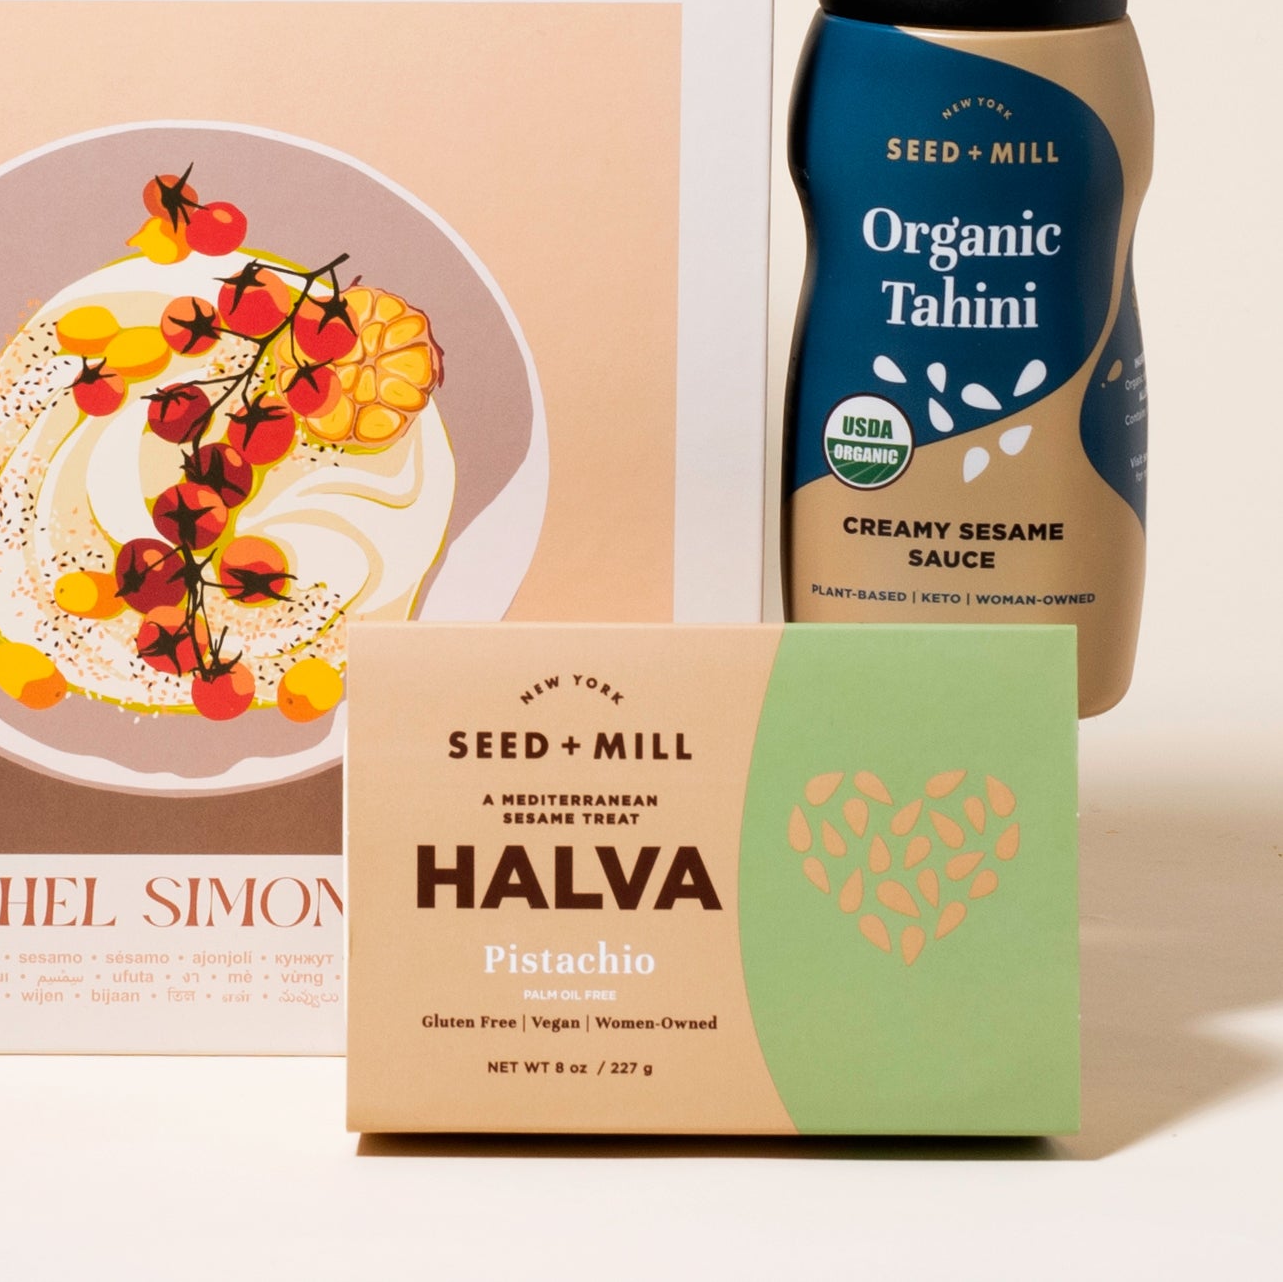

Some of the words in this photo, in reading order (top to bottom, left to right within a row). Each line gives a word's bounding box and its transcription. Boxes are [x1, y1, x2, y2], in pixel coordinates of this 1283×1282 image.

[941, 97, 972, 120] NEW
[977, 97, 1013, 120] YORK
[886, 137, 960, 163] SEED
[967, 144, 983, 161] +
[990, 141, 1059, 165] MILL
[862, 207, 1062, 272] Organic
[881, 275, 1039, 329] Tahini
[842, 415, 893, 440] USDA
[833, 443, 899, 466] ORGANIC
[842, 516, 952, 540] CREAMY
[958, 522, 1064, 542] SESAME
[908, 548, 996, 569] SAUCE
[811, 583, 908, 602] PLANT-BASED
[921, 592, 962, 605] KETO
[975, 592, 1097, 606] WOMAN-OWNED
[519, 675, 559, 705] NEW
[572, 674, 625, 706] YORK
[448, 730, 550, 760] SEED
[561, 735, 581, 756] +
[593, 732, 693, 761] MILL
[482, 793, 495, 806] A
[501, 793, 658, 807] MEDITERRANEAN
[502, 812, 575, 825] SESAME
[581, 812, 640, 825] TREAT
[416, 844, 723, 911] HALVA
[142, 877, 343, 928] SIMON
[18, 952, 83, 965] sesamo
[105, 950, 170, 965] sésamo
[274, 953, 335, 968] кунжут
[484, 940, 656, 975] Pistachio
[112, 969, 154, 984] ufuta
[20, 987, 64, 1006] wijen
[90, 988, 140, 1006] bijaan
[523, 989, 558, 1001] PALM
[559, 989, 582, 1001] OIL
[584, 989, 617, 1001] FREE
[421, 1013, 475, 1029] Gluten
[480, 1015, 517, 1029] Free
[531, 1016, 581, 1033] Vegan
[595, 1014, 718, 1030] Women-Owned
[487, 1061, 519, 1074] NET
[524, 1061, 551, 1074] WT
[554, 1061, 565, 1074] 8
[569, 1063, 588, 1074] oz
[596, 1060, 606, 1076] /
[610, 1061, 638, 1075] 227
[642, 1064, 653, 1077] g
